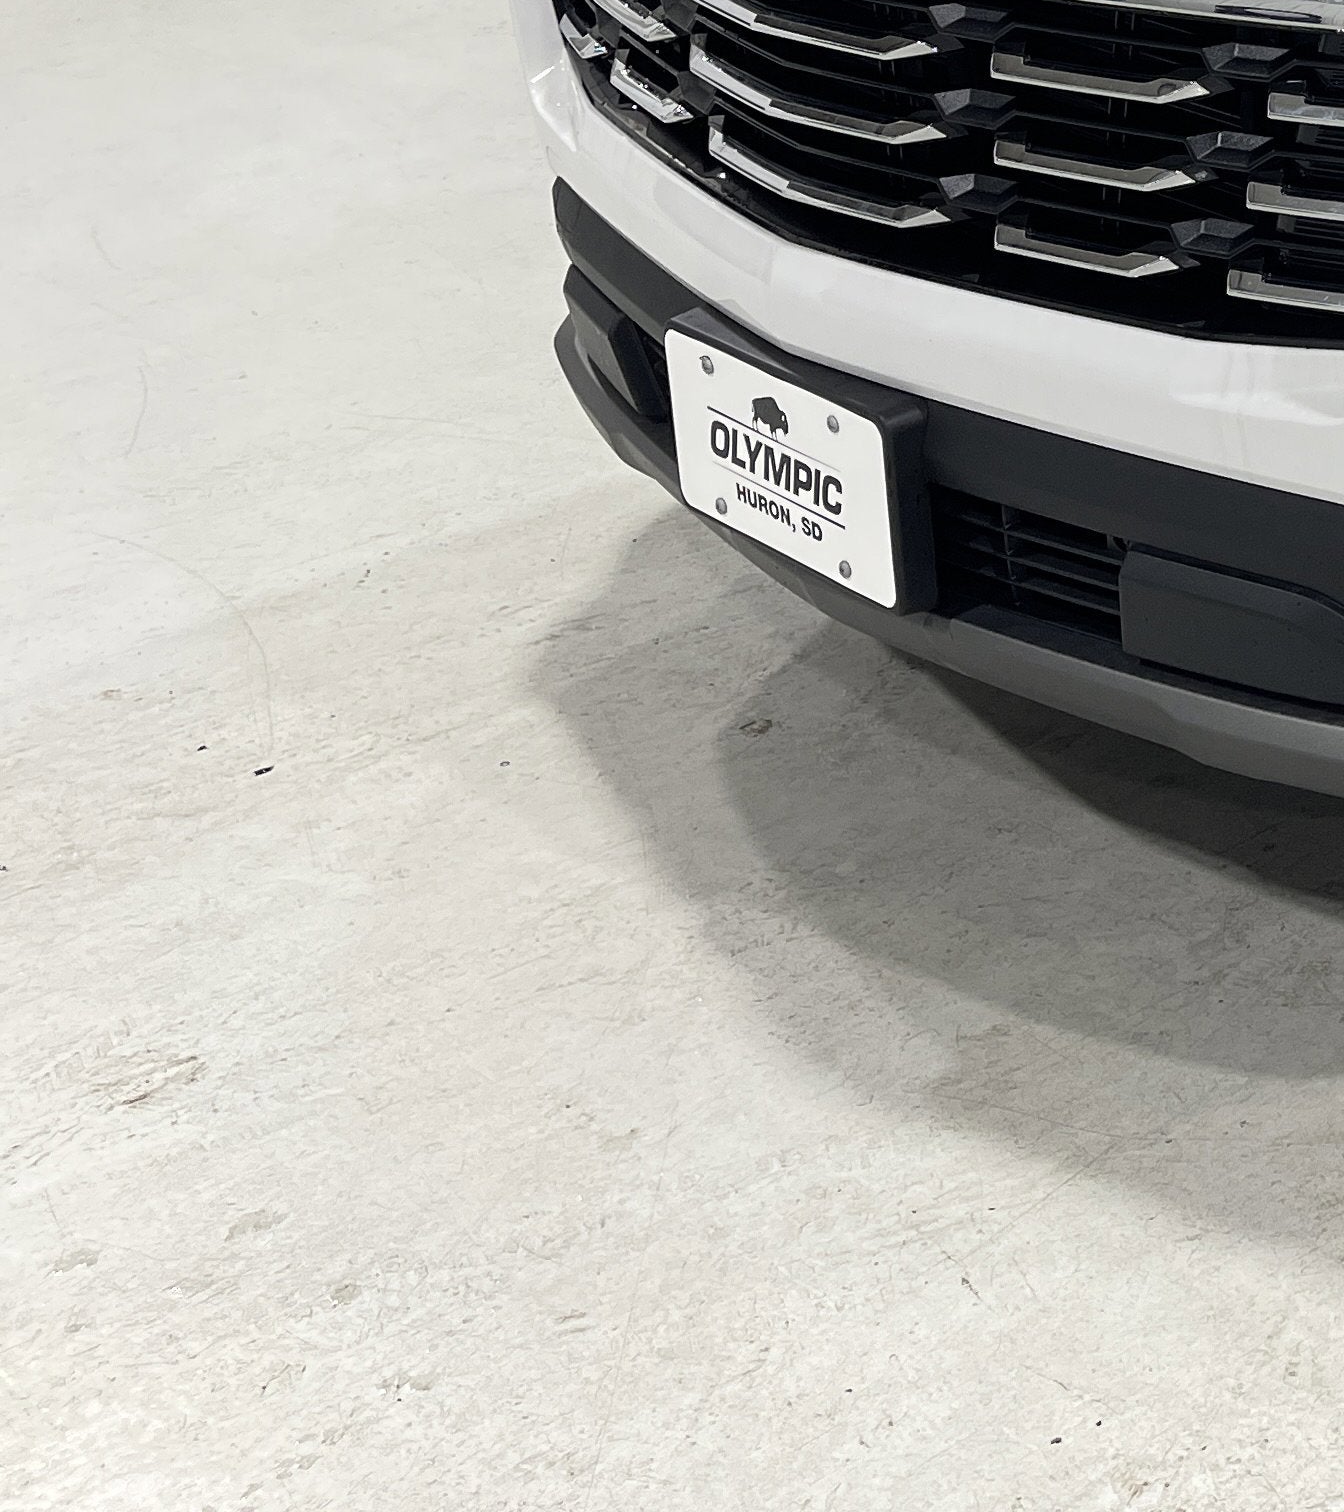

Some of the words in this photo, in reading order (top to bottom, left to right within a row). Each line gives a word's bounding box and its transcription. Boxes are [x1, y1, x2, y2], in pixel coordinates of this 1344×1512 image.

[711, 420, 842, 516] OLYMPIC
[736, 483, 797, 533] HURON,
[801, 516, 823, 541] SD
